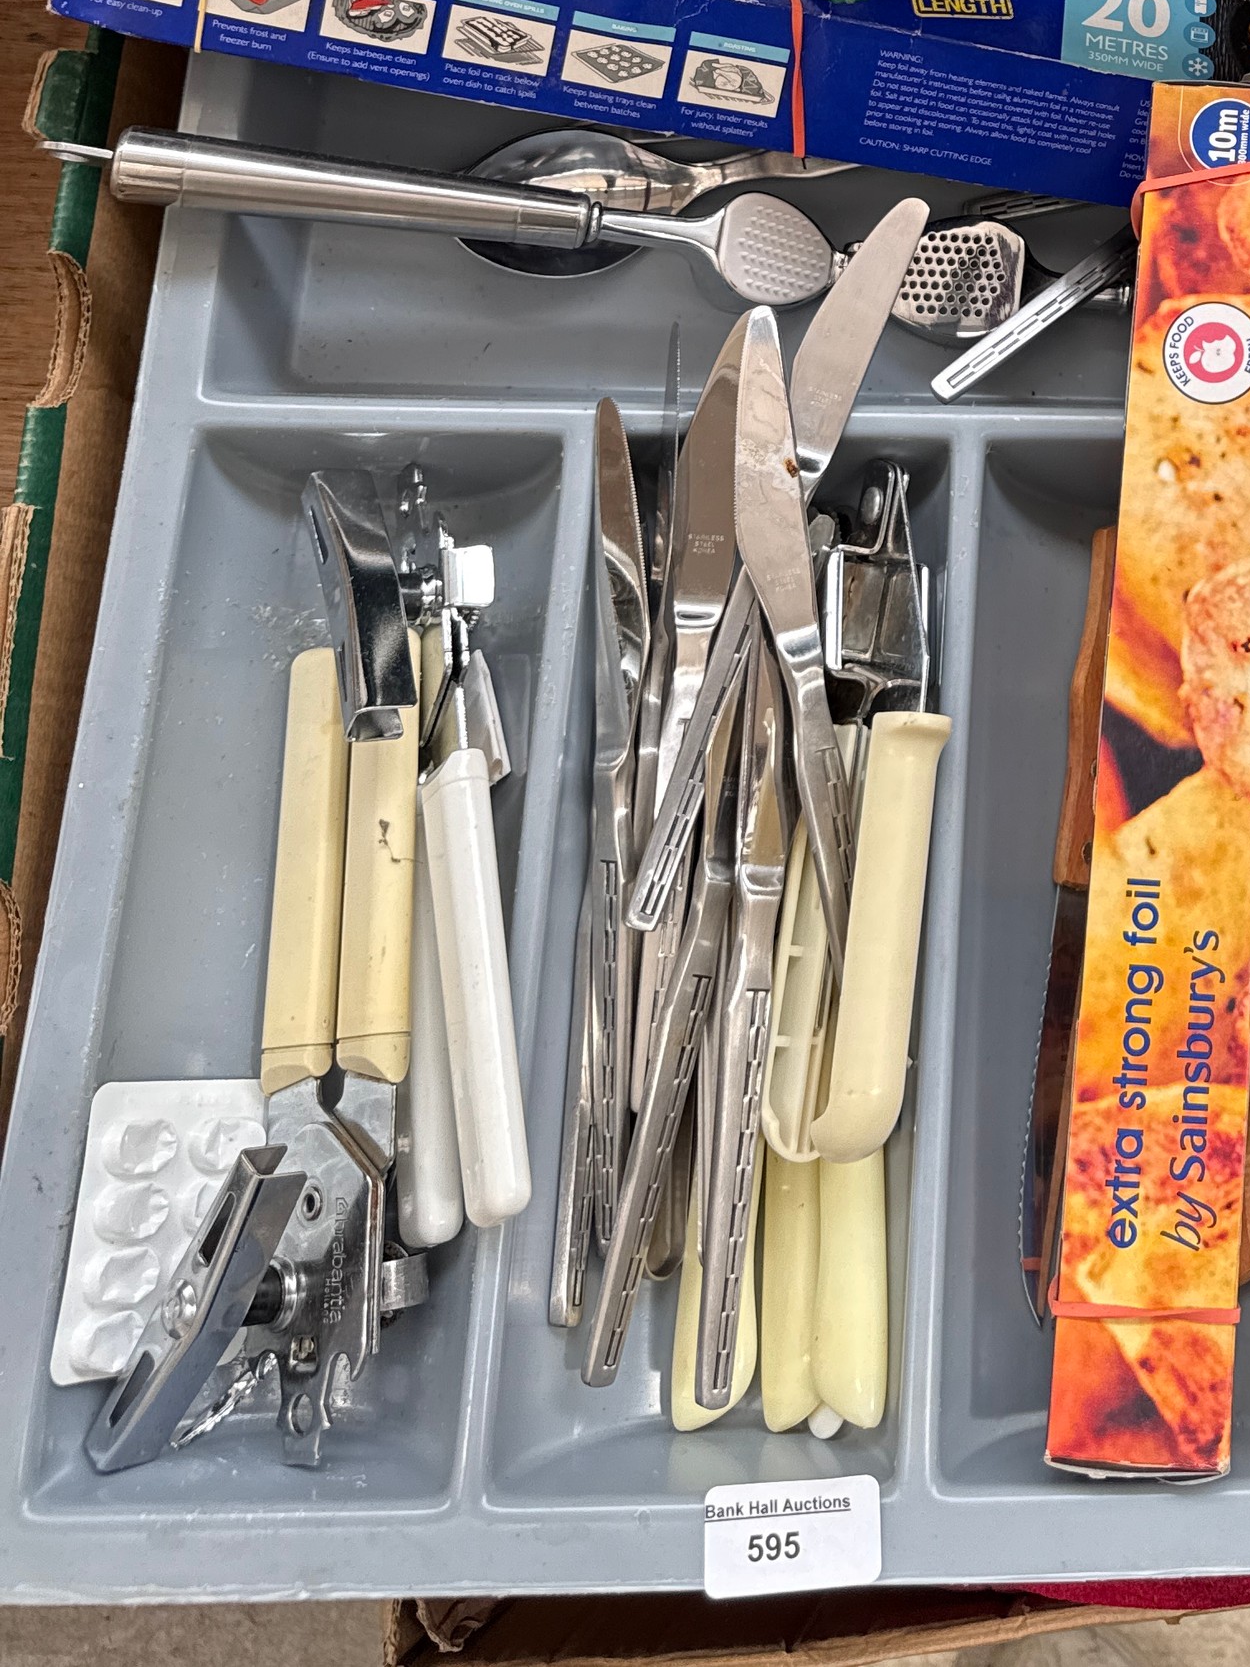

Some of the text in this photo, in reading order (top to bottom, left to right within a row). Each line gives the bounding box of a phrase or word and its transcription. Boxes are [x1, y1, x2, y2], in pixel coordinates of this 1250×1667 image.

[127, 1, 163, 17] clean-up
[212, 19, 249, 34] Prevents
[249, 26, 269, 38] frost
[219, 34, 272, 51] freezer burn
[326, 42, 417, 65] Keeps barbeque clean
[1085, 33, 1169, 61] METRES
[307, 51, 340, 65] (Ensure
[390, 65, 431, 82] openings)
[880, 50, 924, 64] WARNING!
[1088, 50, 1164, 72] 350MM WIDE
[442, 76, 465, 87] oven
[495, 84, 517, 95] catch
[444, 63, 467, 75] Place
[513, 75, 540, 87] below
[562, 86, 657, 110] Keeps baking trays clean
[874, 70, 927, 85] manufacturer's
[929, 80, 968, 93] instructions
[1012, 96, 1049, 108] aluminium
[948, 73, 975, 86] heating
[975, 79, 1007, 91] elements
[1070, 97, 1094, 108] Always
[1095, 101, 1120, 112] consult
[573, 99, 641, 119] between batches
[716, 112, 743, 124] tender
[743, 118, 769, 129] results
[1240, 109, 1250, 131] wide
[691, 119, 754, 138] without splatters
[1208, 109, 1238, 162] 10m
[902, 143, 929, 155] SHARP
[929, 148, 969, 162] CUTTING
[969, 155, 993, 166] EDGE
[1168, 315, 1195, 387] KEEPS FOOD
[1105, 878, 1165, 1249] extra strong foil
[1159, 928, 1226, 1252] by Sainsbury's
[705, 1495, 851, 1519] Bank Hall Auctions
[747, 1531, 801, 1563] 595
